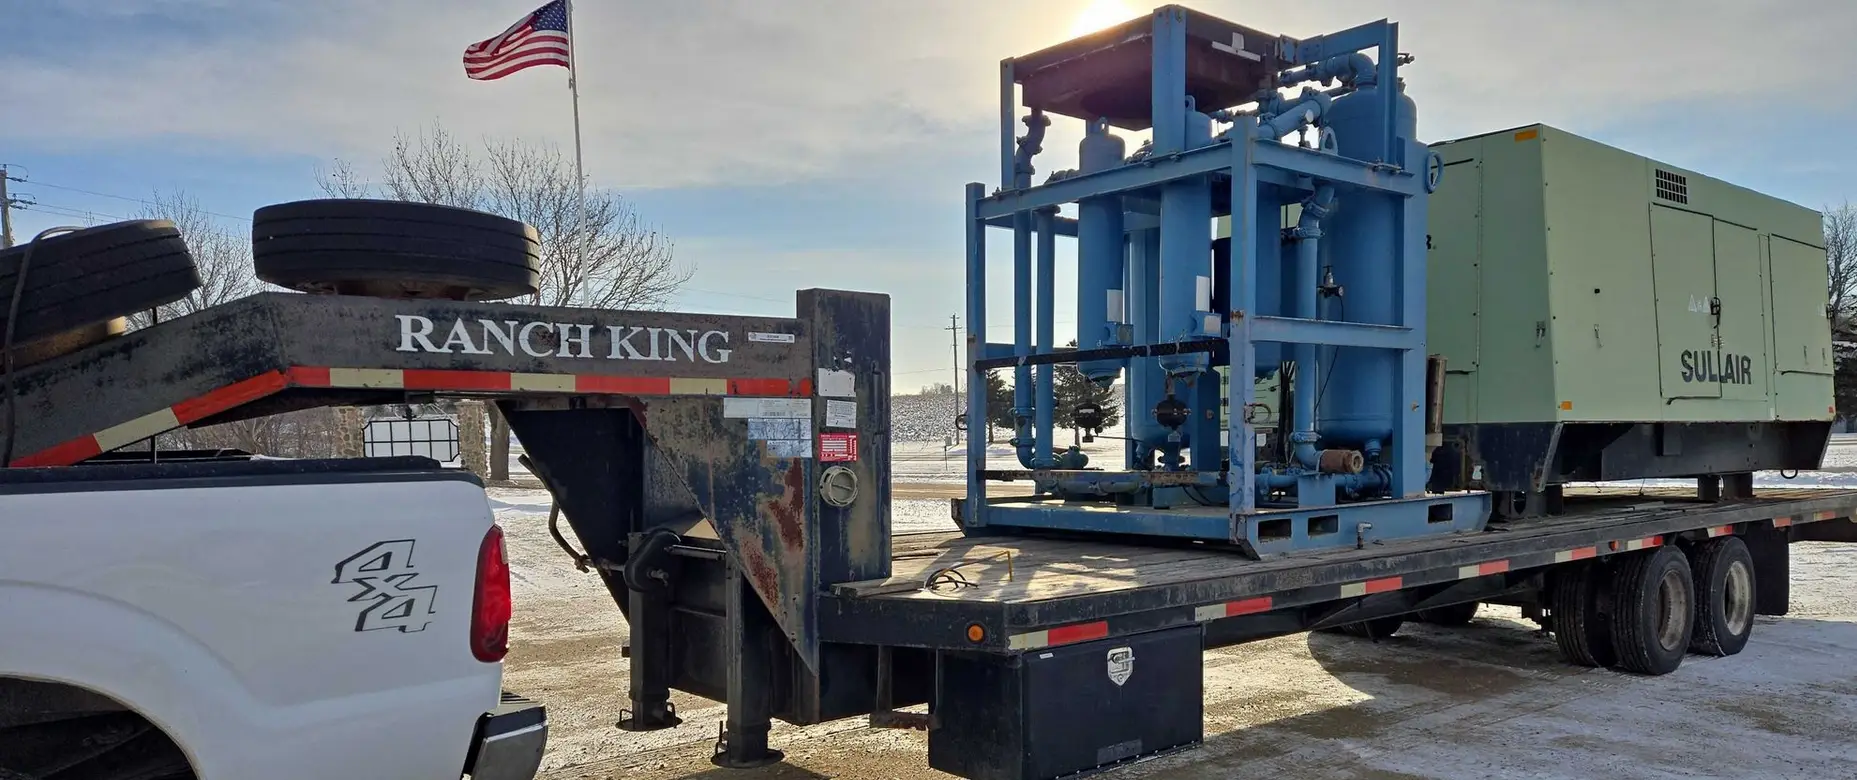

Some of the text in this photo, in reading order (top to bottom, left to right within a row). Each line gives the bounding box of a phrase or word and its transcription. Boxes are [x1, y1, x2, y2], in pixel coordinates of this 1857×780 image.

[395, 314, 732, 364] RANCH KING
[1680, 349, 1752, 385] SULLAIR
